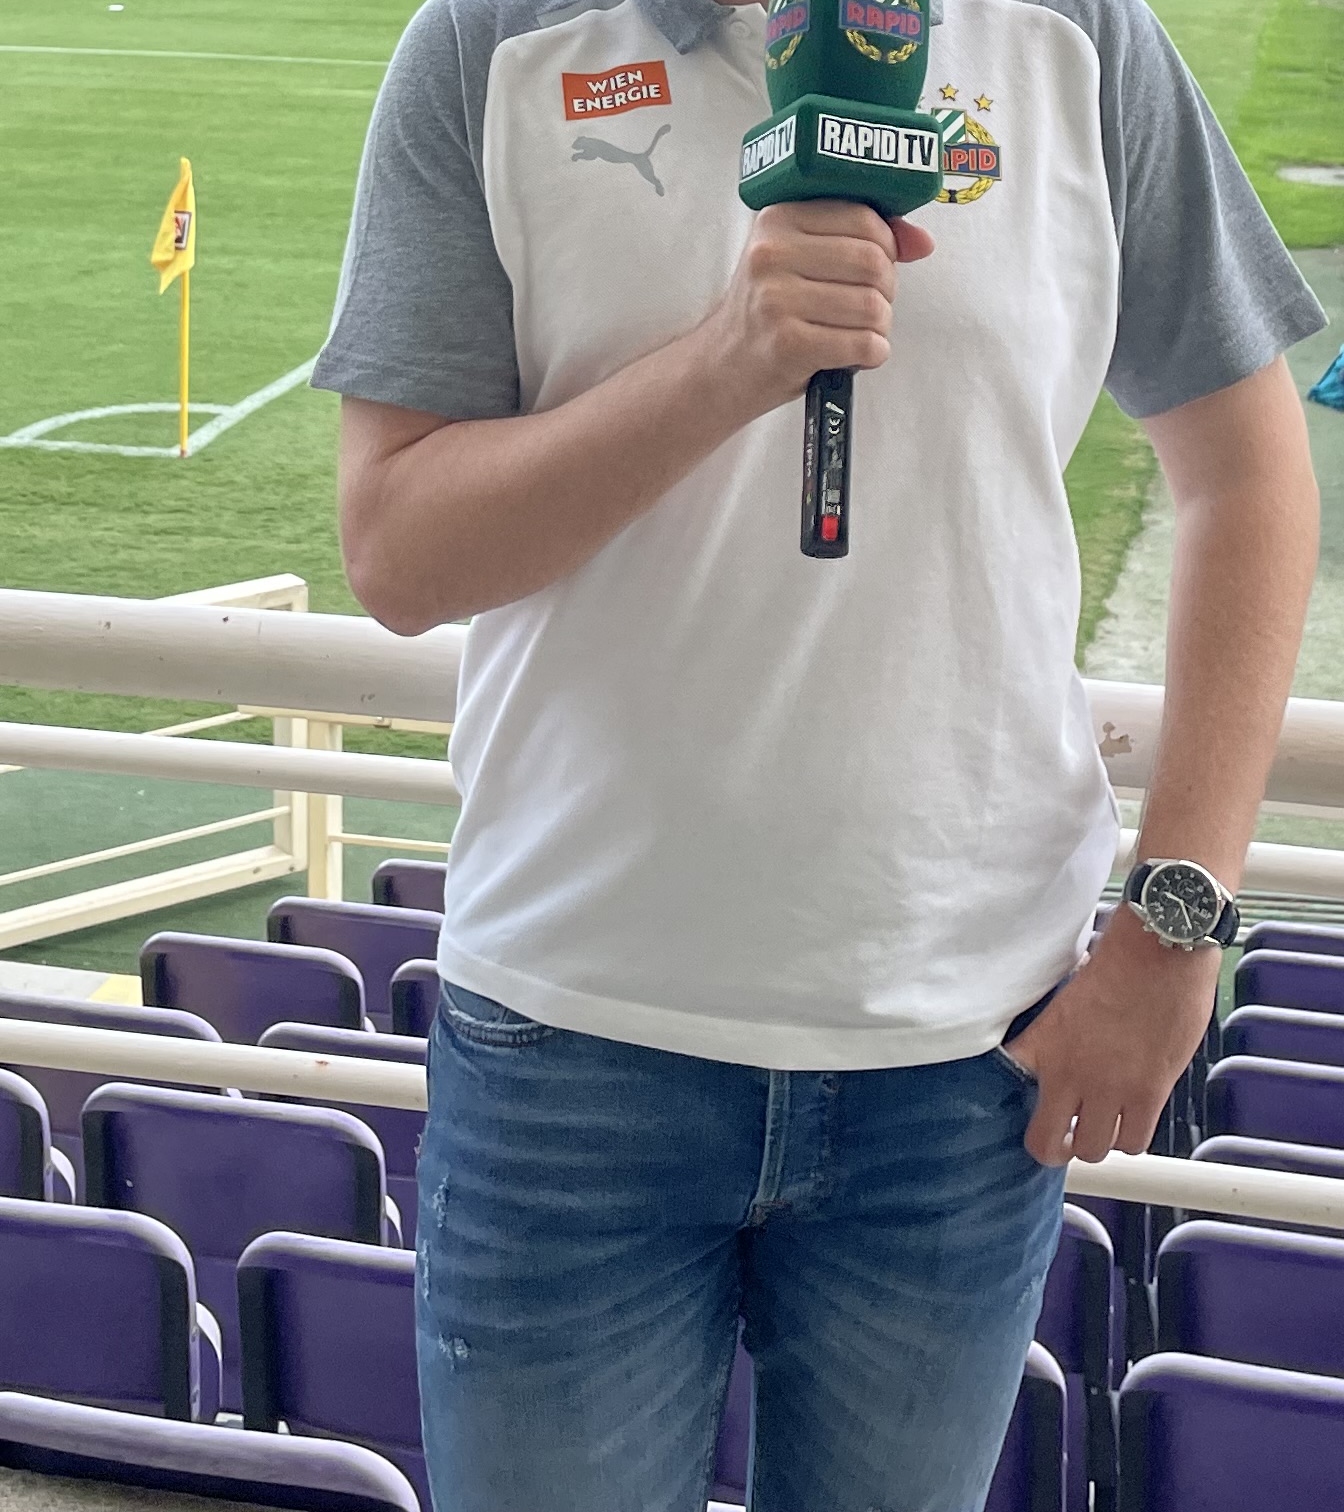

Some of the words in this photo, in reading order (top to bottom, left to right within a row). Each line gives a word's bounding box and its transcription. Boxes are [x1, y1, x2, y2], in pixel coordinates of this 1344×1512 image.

[846, 0, 921, 36] RAPID
[572, 84, 662, 114] ENERGIE
[586, 70, 644, 95] WIEN
[742, 129, 775, 176] RAPID
[776, 119, 795, 159] TV
[822, 119, 899, 163] RAPID
[903, 133, 936, 167] TV
